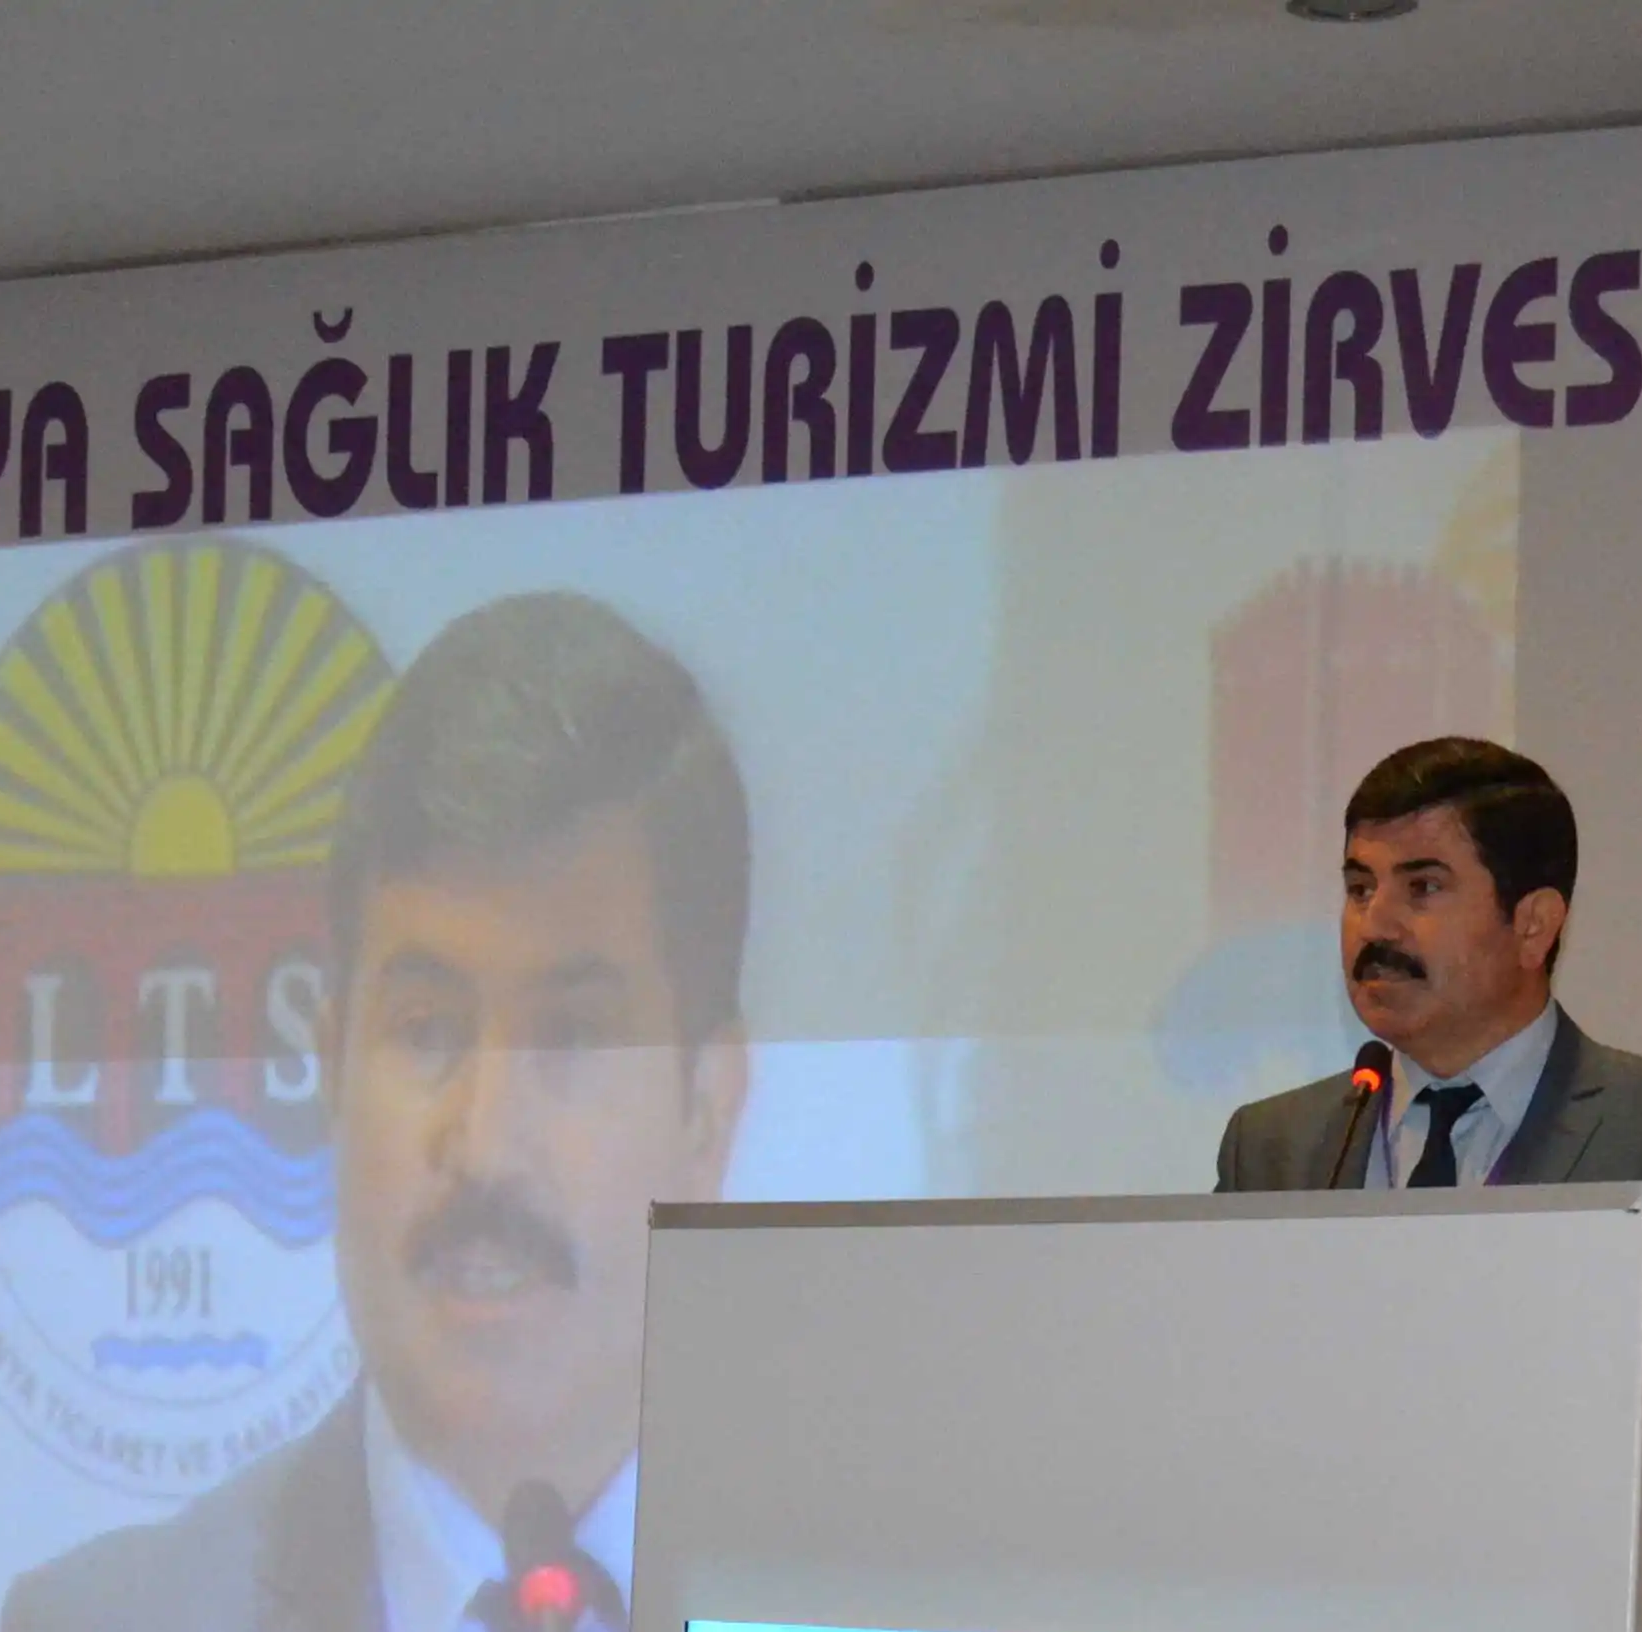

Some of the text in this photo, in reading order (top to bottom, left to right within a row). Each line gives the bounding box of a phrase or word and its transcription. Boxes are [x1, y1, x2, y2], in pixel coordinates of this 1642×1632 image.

[131, 307, 561, 531] SAĞLIK
[601, 238, 1124, 495] TURİZMİ
[125, 1244, 213, 1320] 1991
